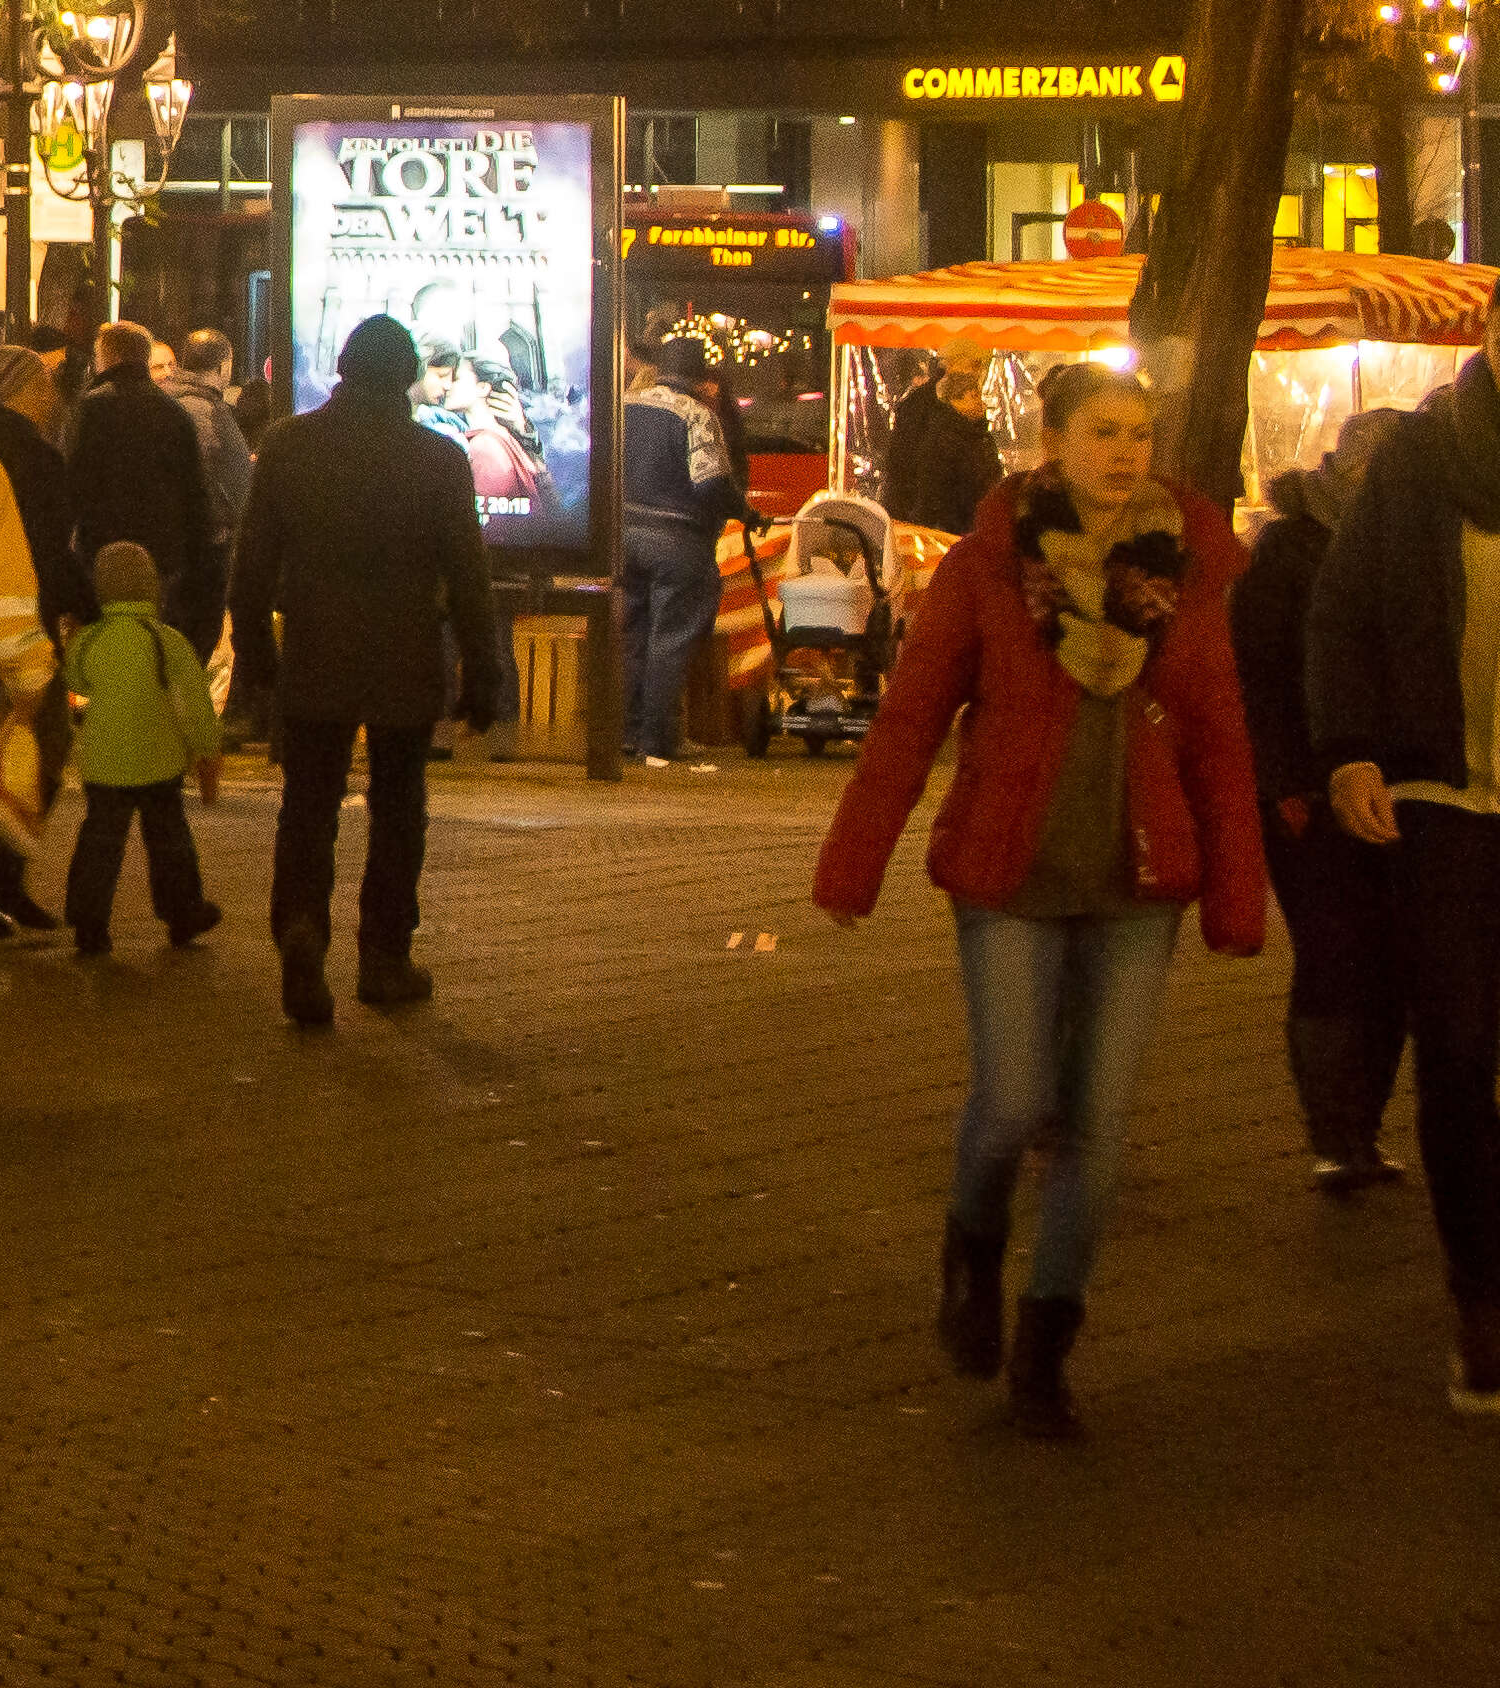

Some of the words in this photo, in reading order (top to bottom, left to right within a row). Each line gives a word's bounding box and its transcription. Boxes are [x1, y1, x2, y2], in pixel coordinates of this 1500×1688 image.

[903, 66, 1143, 99] COMMERZBANK
[477, 130, 533, 152] DIE
[338, 150, 539, 198] TORE
[384, 201, 548, 244] WELT
[710, 246, 753, 268] Thon
